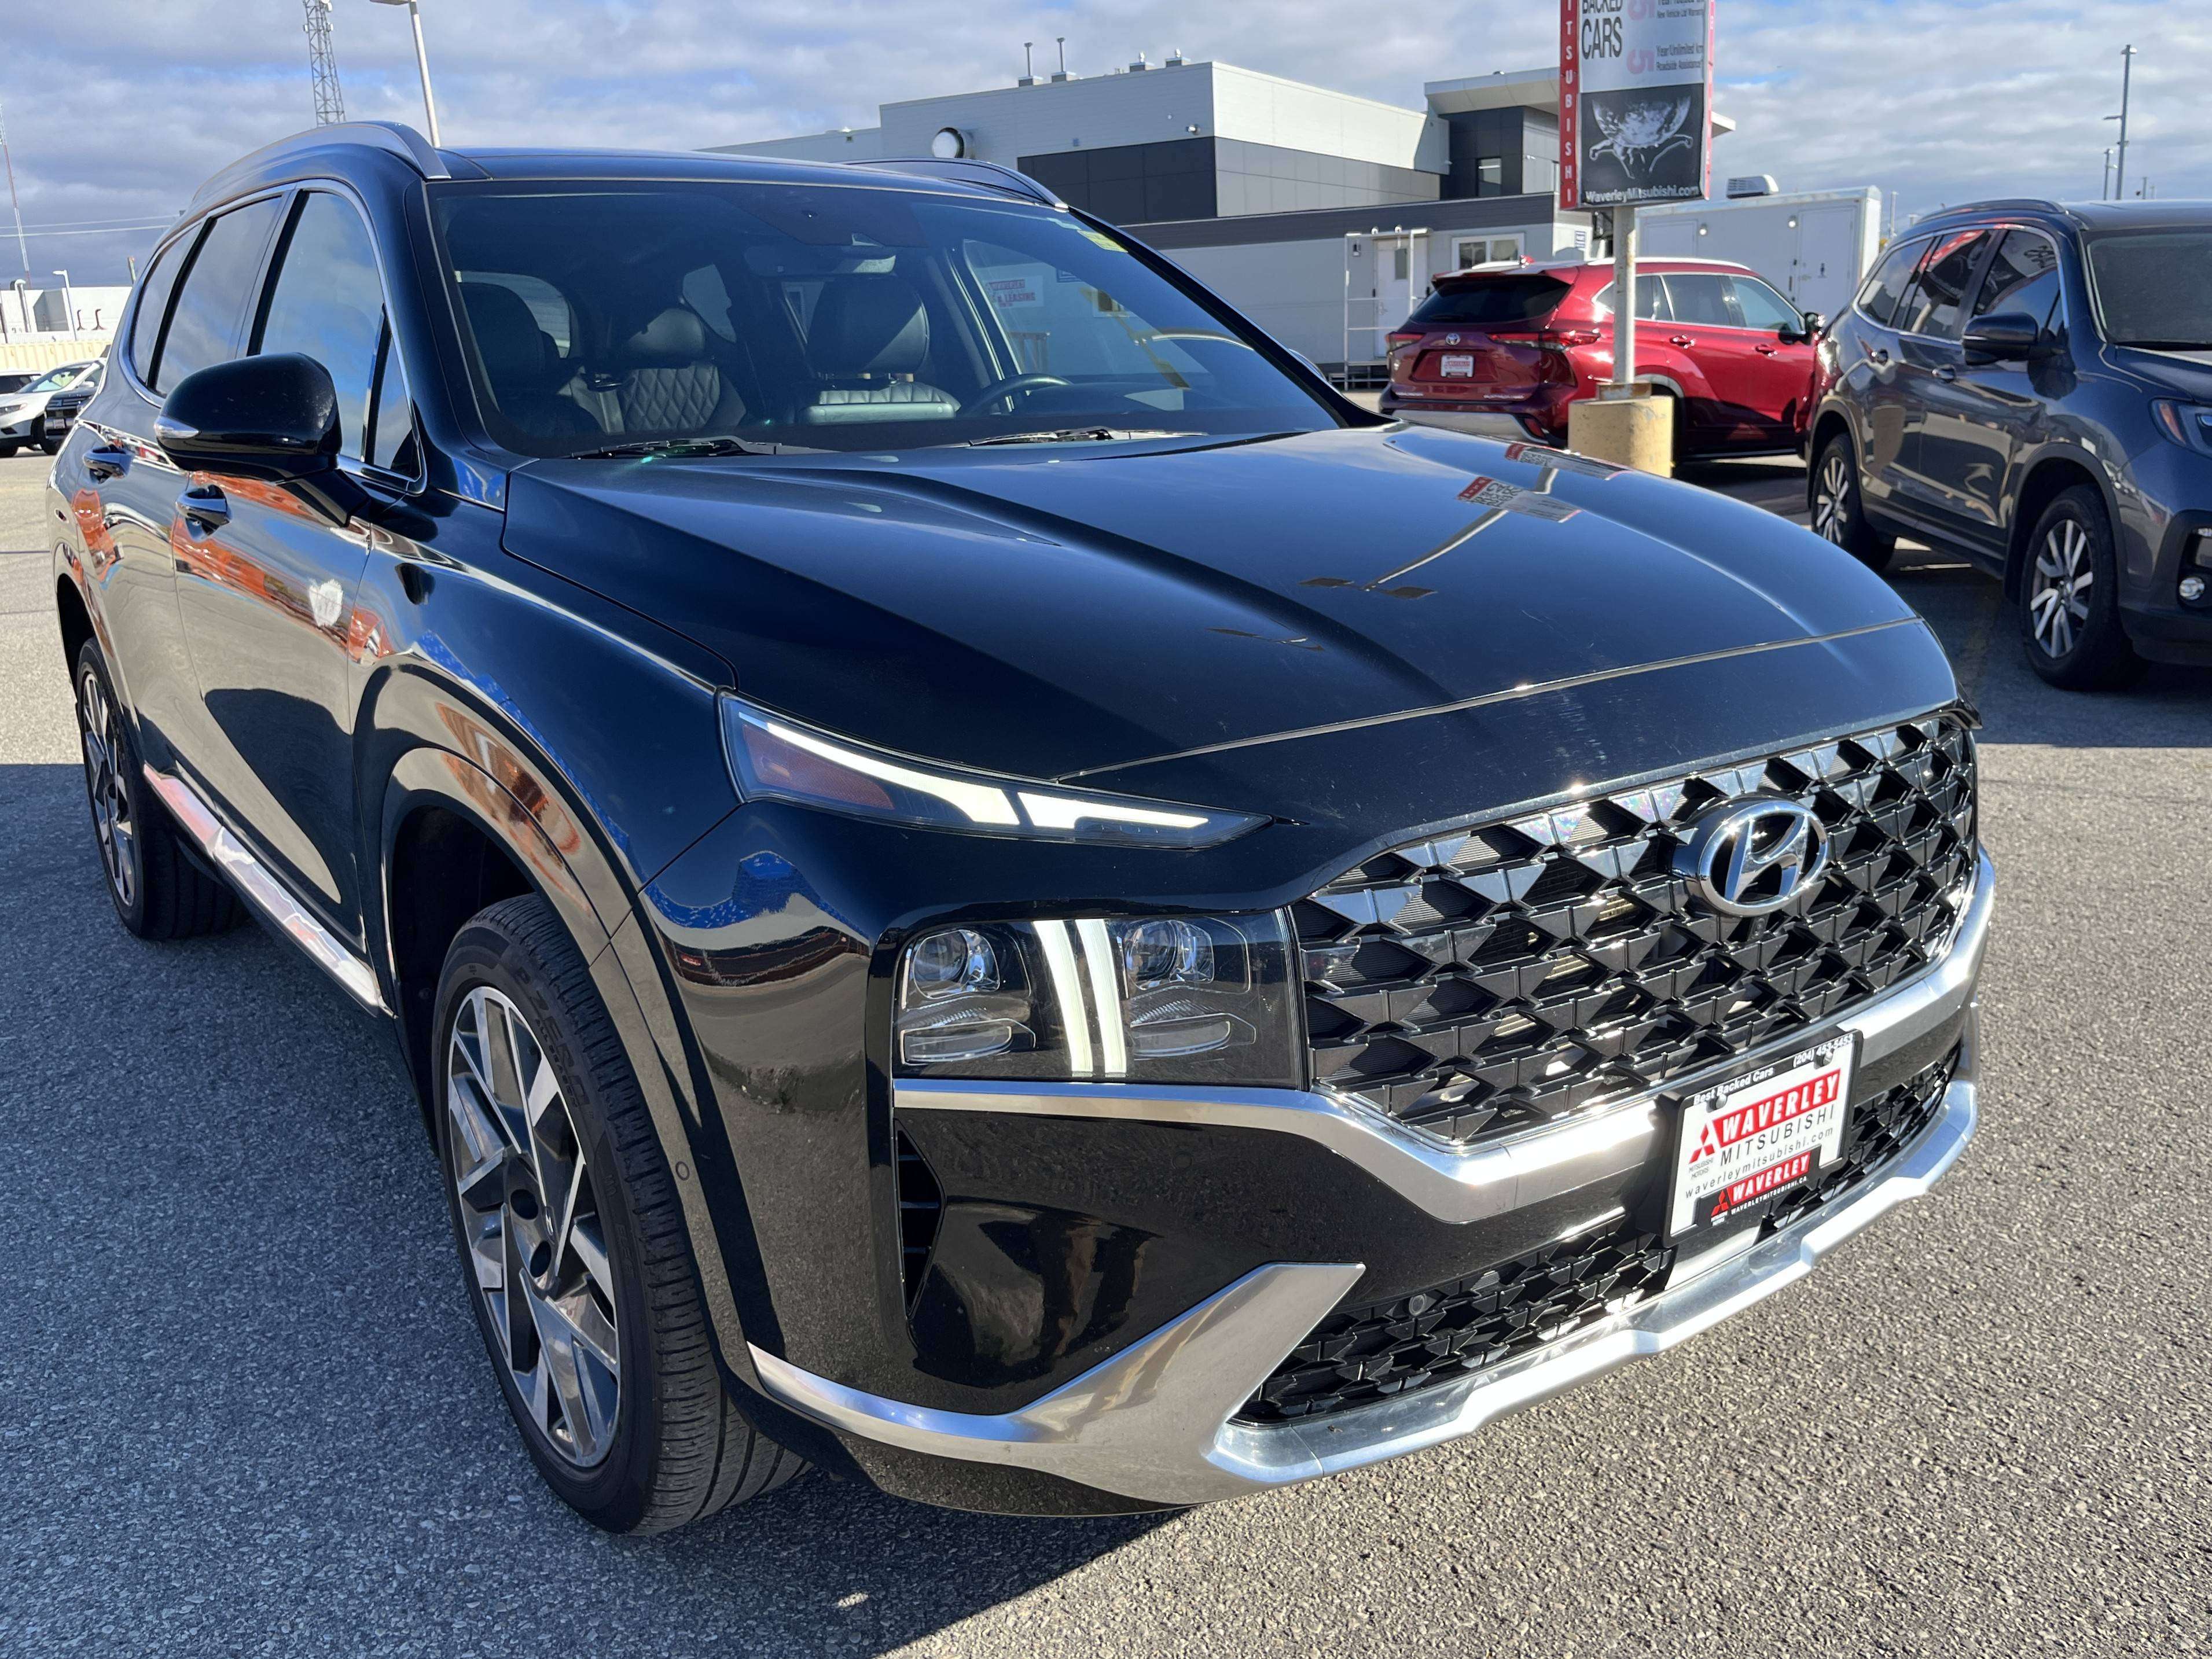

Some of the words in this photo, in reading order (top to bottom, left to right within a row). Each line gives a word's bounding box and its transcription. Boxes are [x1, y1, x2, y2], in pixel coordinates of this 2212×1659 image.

[1582, 16, 1623, 60] CARS
[1585, 185, 1699, 203] WaverleyMitsubishi.com
[1793, 1048, 1814, 1068] (204)
[1693, 1089, 1715, 1105] Best
[1717, 1074, 1751, 1097] Backed
[1752, 1068, 1773, 1082] Cars
[1722, 1073, 1839, 1143] WAVERLEY
[1720, 1104, 1833, 1166] MITSUBISHI
[1685, 1128, 1833, 1198] waverleymitsubishi.com
[1733, 1155, 1809, 1202] WAVERLEY
